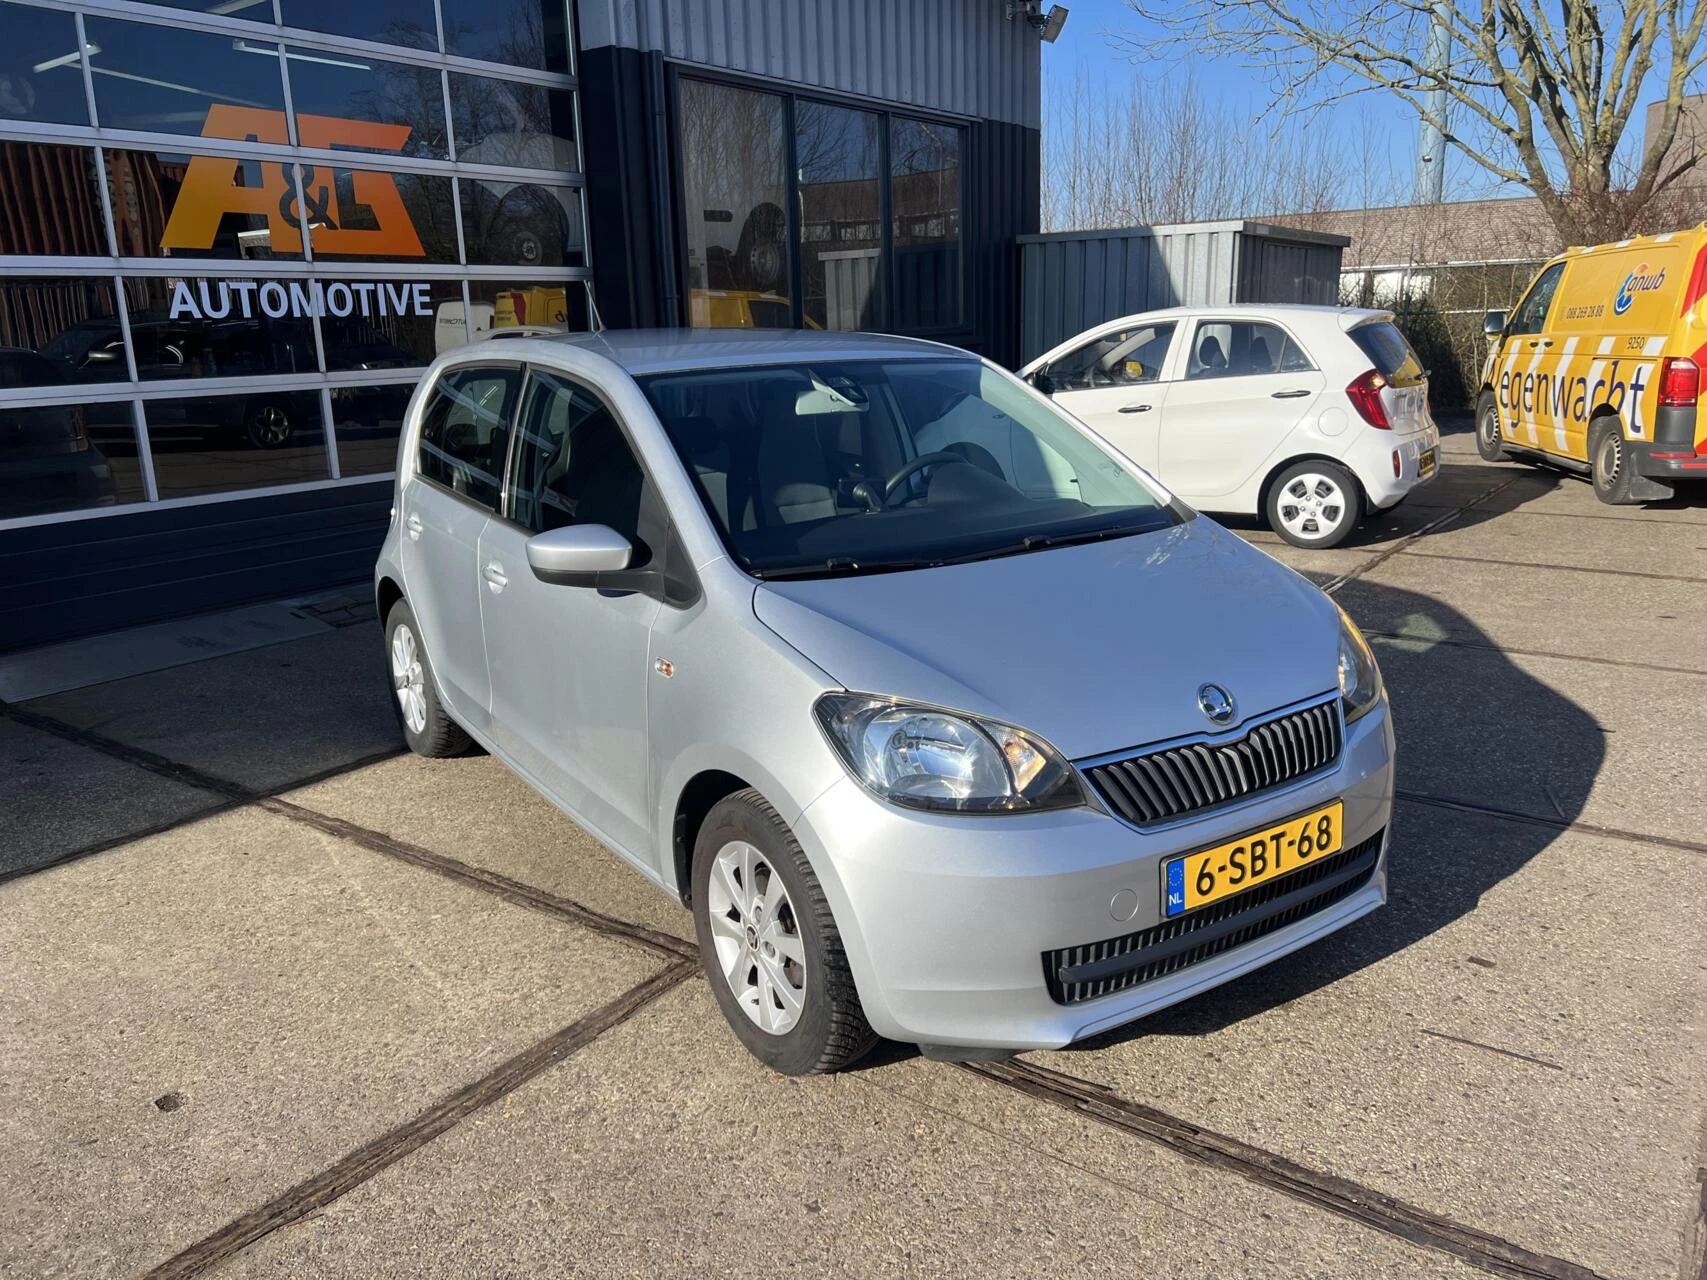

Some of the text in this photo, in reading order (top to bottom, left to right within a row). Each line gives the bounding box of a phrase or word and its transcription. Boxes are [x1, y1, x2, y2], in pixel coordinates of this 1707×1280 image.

[1627, 266, 1665, 292] anwb
[169, 282, 433, 319] AUTOMOTIVE
[1627, 336, 1645, 349] 9250
[1196, 815, 1332, 896] 6-SBT-68
[1169, 891, 1183, 906] NL
